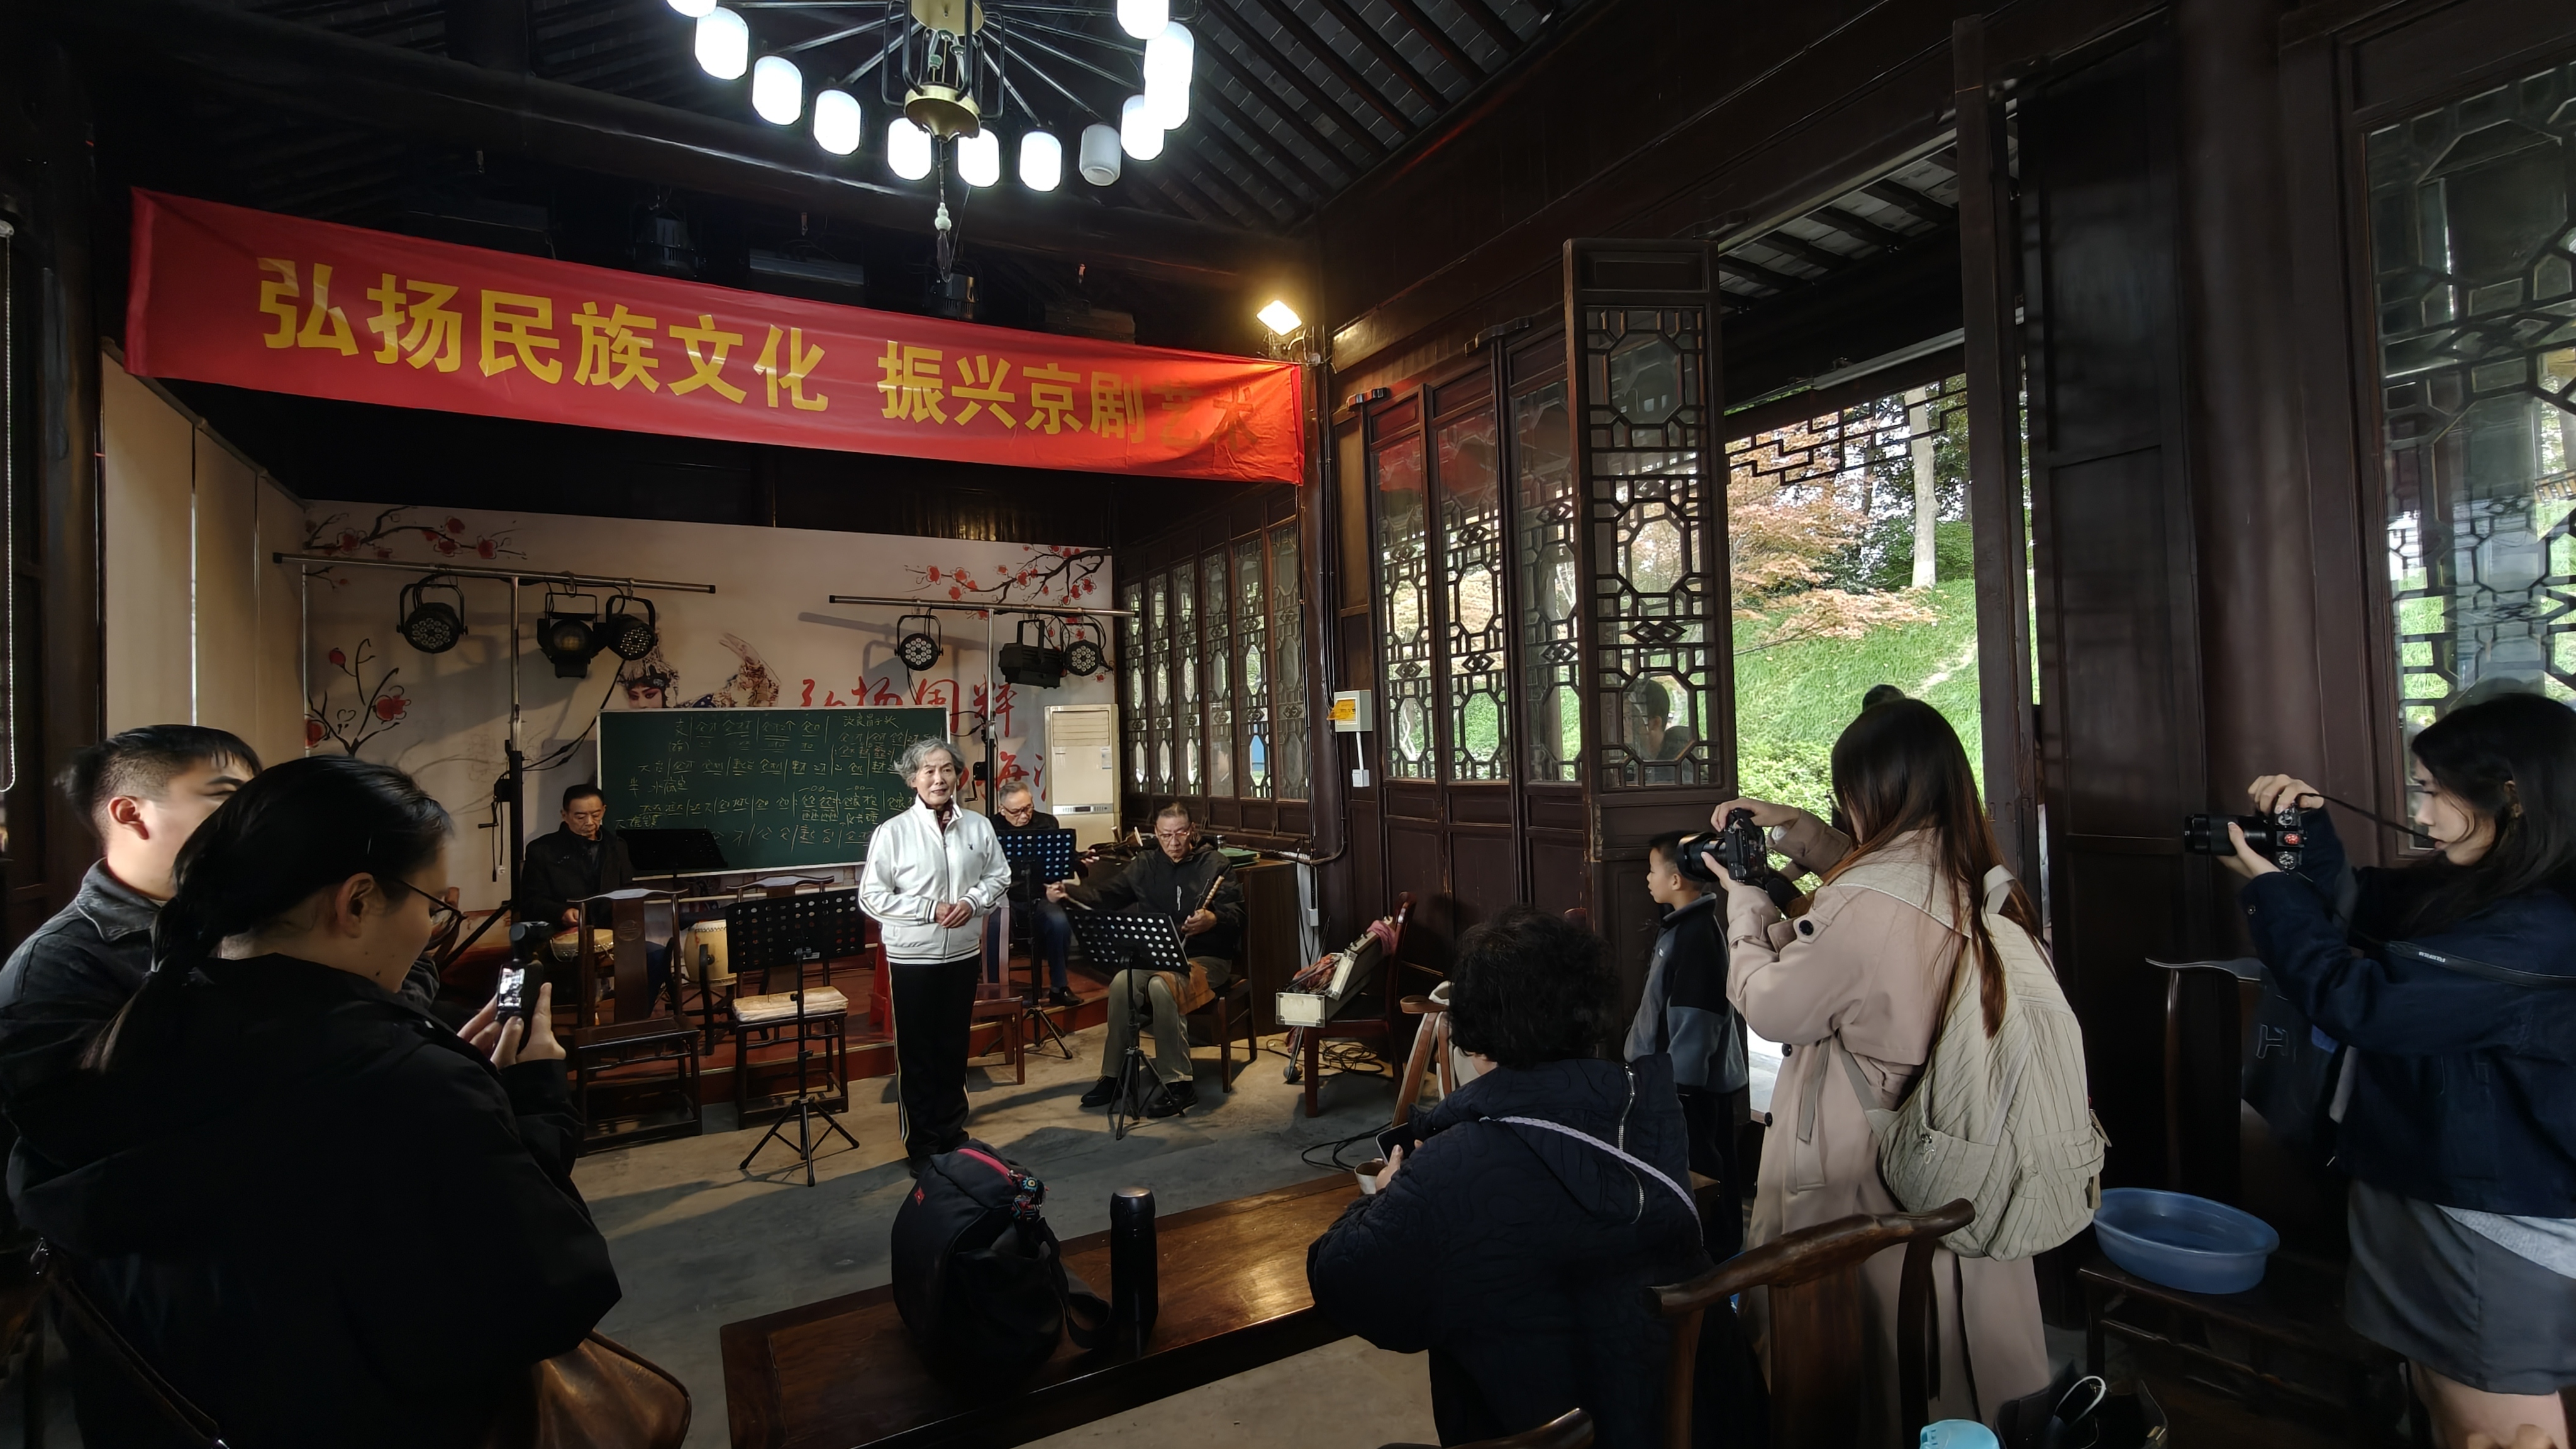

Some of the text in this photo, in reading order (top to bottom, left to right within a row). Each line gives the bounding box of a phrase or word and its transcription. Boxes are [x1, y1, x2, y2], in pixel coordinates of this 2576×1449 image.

[257, 257, 1259, 450] 弘扬民族文化 振兴京剧艺术
